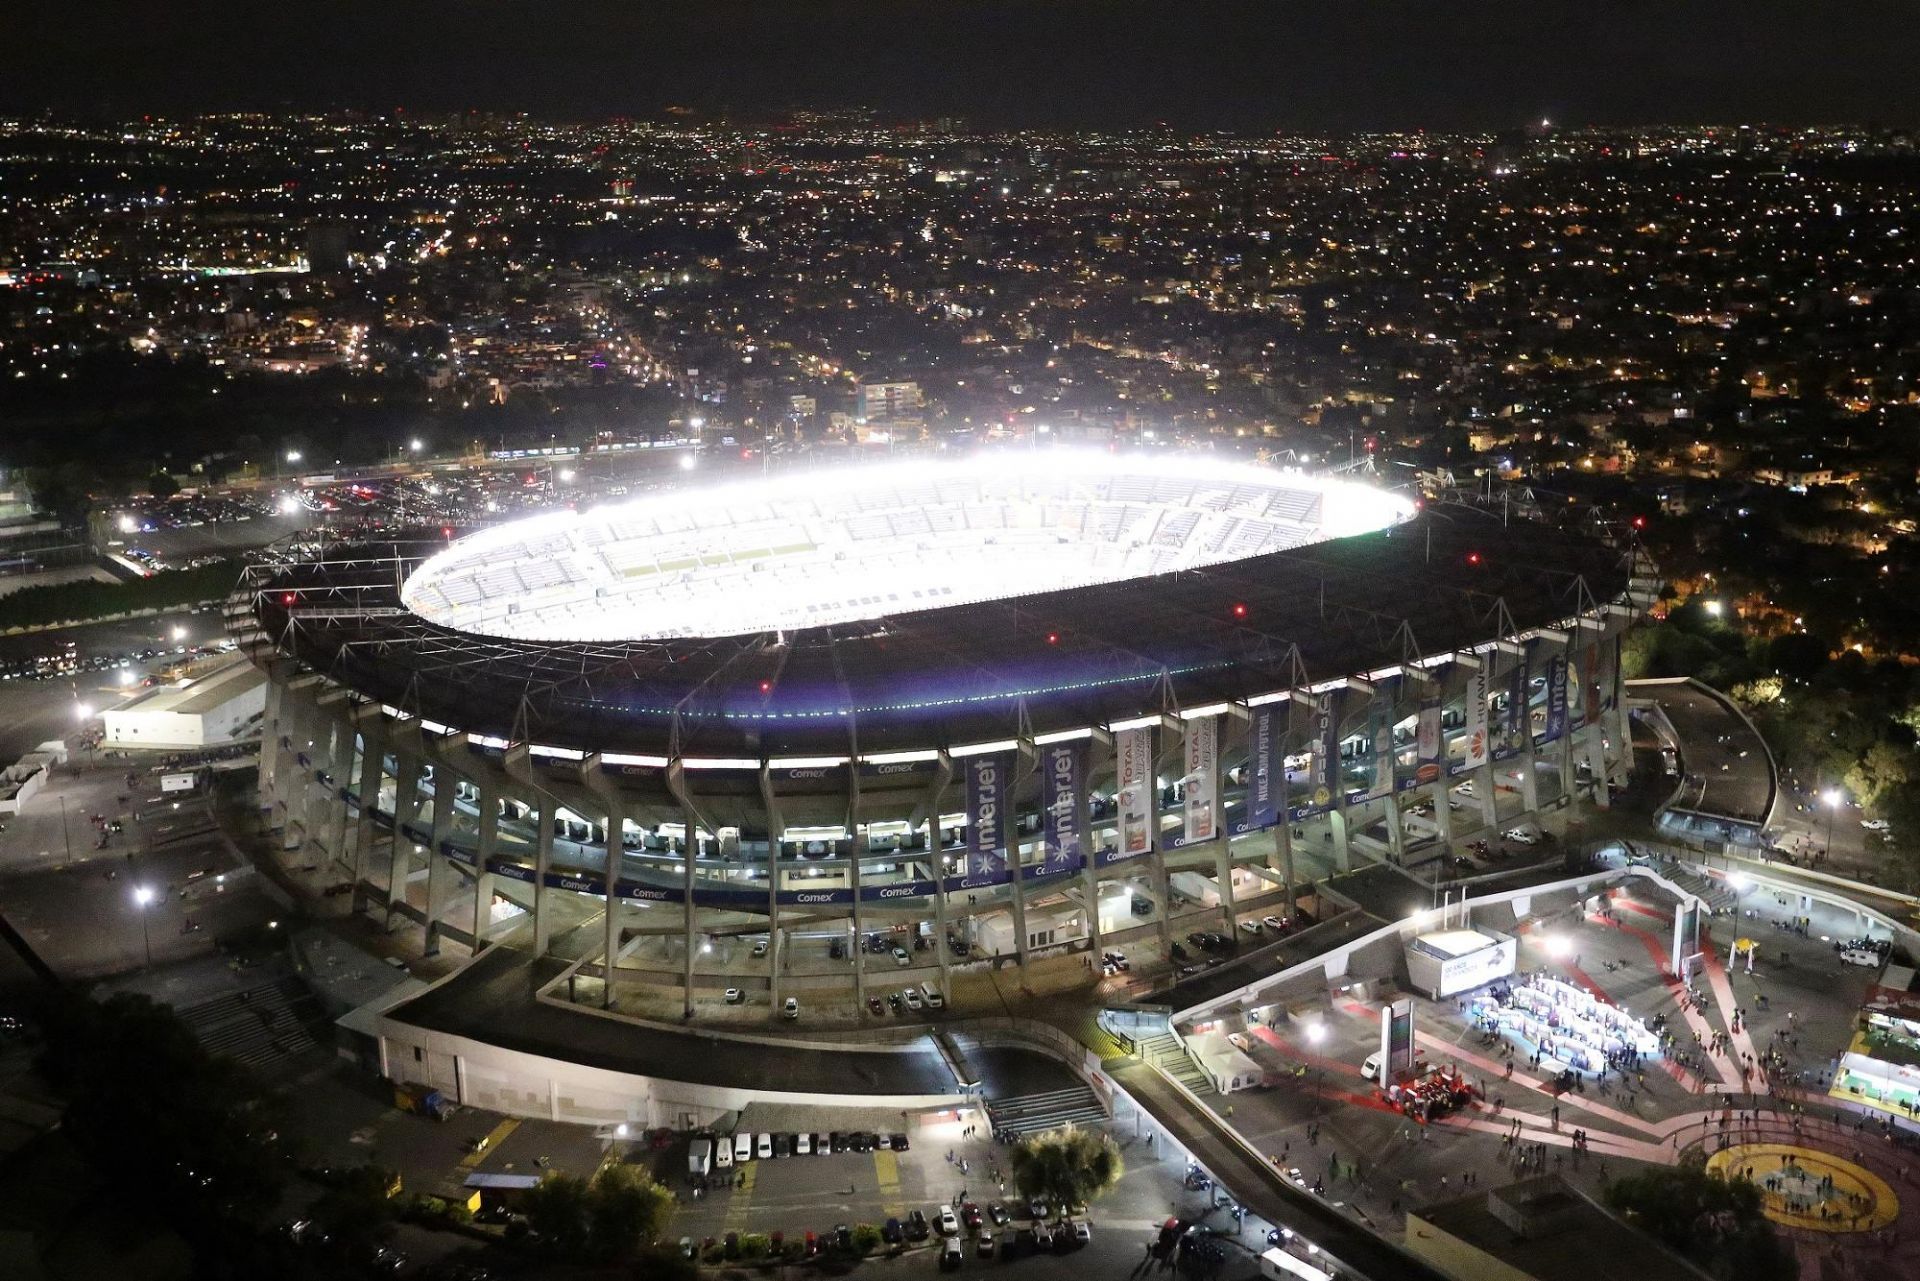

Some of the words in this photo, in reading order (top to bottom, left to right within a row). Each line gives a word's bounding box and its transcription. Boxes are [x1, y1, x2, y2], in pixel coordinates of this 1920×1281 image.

[1191, 726, 1199, 773] TOTAL
[1123, 738, 1133, 786] TOTAL
[789, 768, 828, 779] Comex
[878, 763, 915, 775] Comex
[560, 879, 592, 892] Comex
[633, 888, 669, 899] Comex
[797, 892, 835, 903] Comex
[879, 886, 917, 898] Comex
